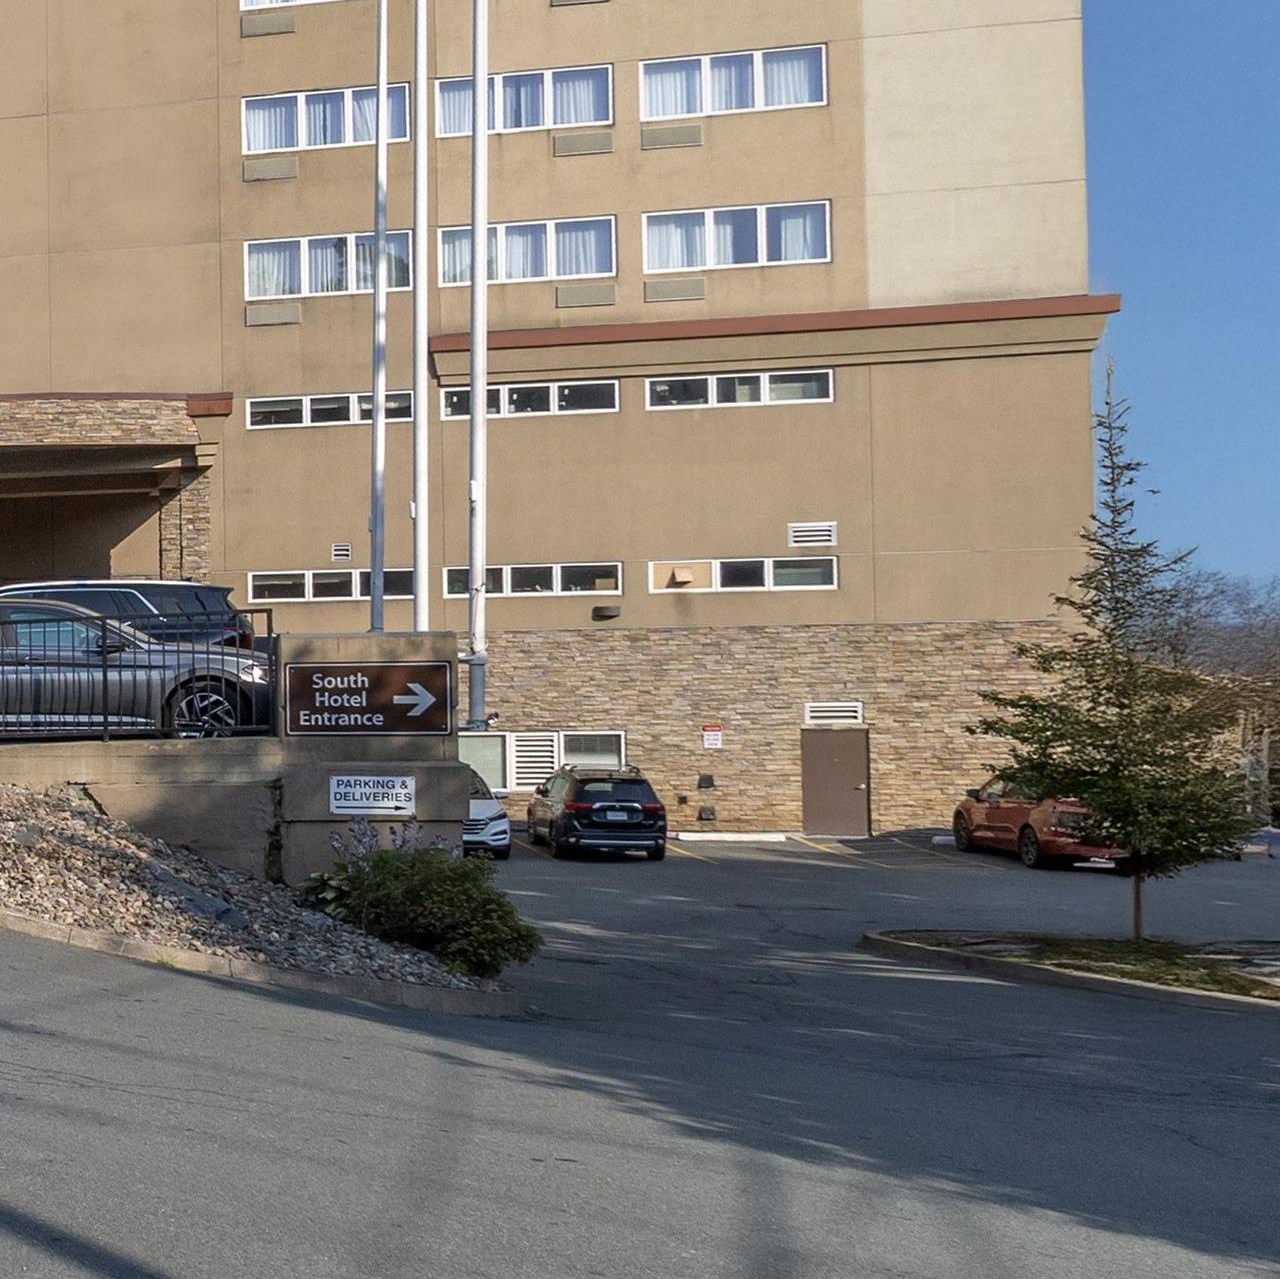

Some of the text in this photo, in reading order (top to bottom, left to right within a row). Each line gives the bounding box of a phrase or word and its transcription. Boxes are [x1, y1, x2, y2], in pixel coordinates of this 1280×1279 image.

[312, 672, 369, 689] South
[315, 691, 367, 707] Hotel
[299, 710, 385, 726] Entrance
[336, 779, 409, 790] PARKING &
[333, 792, 413, 803] DELIVERIES
